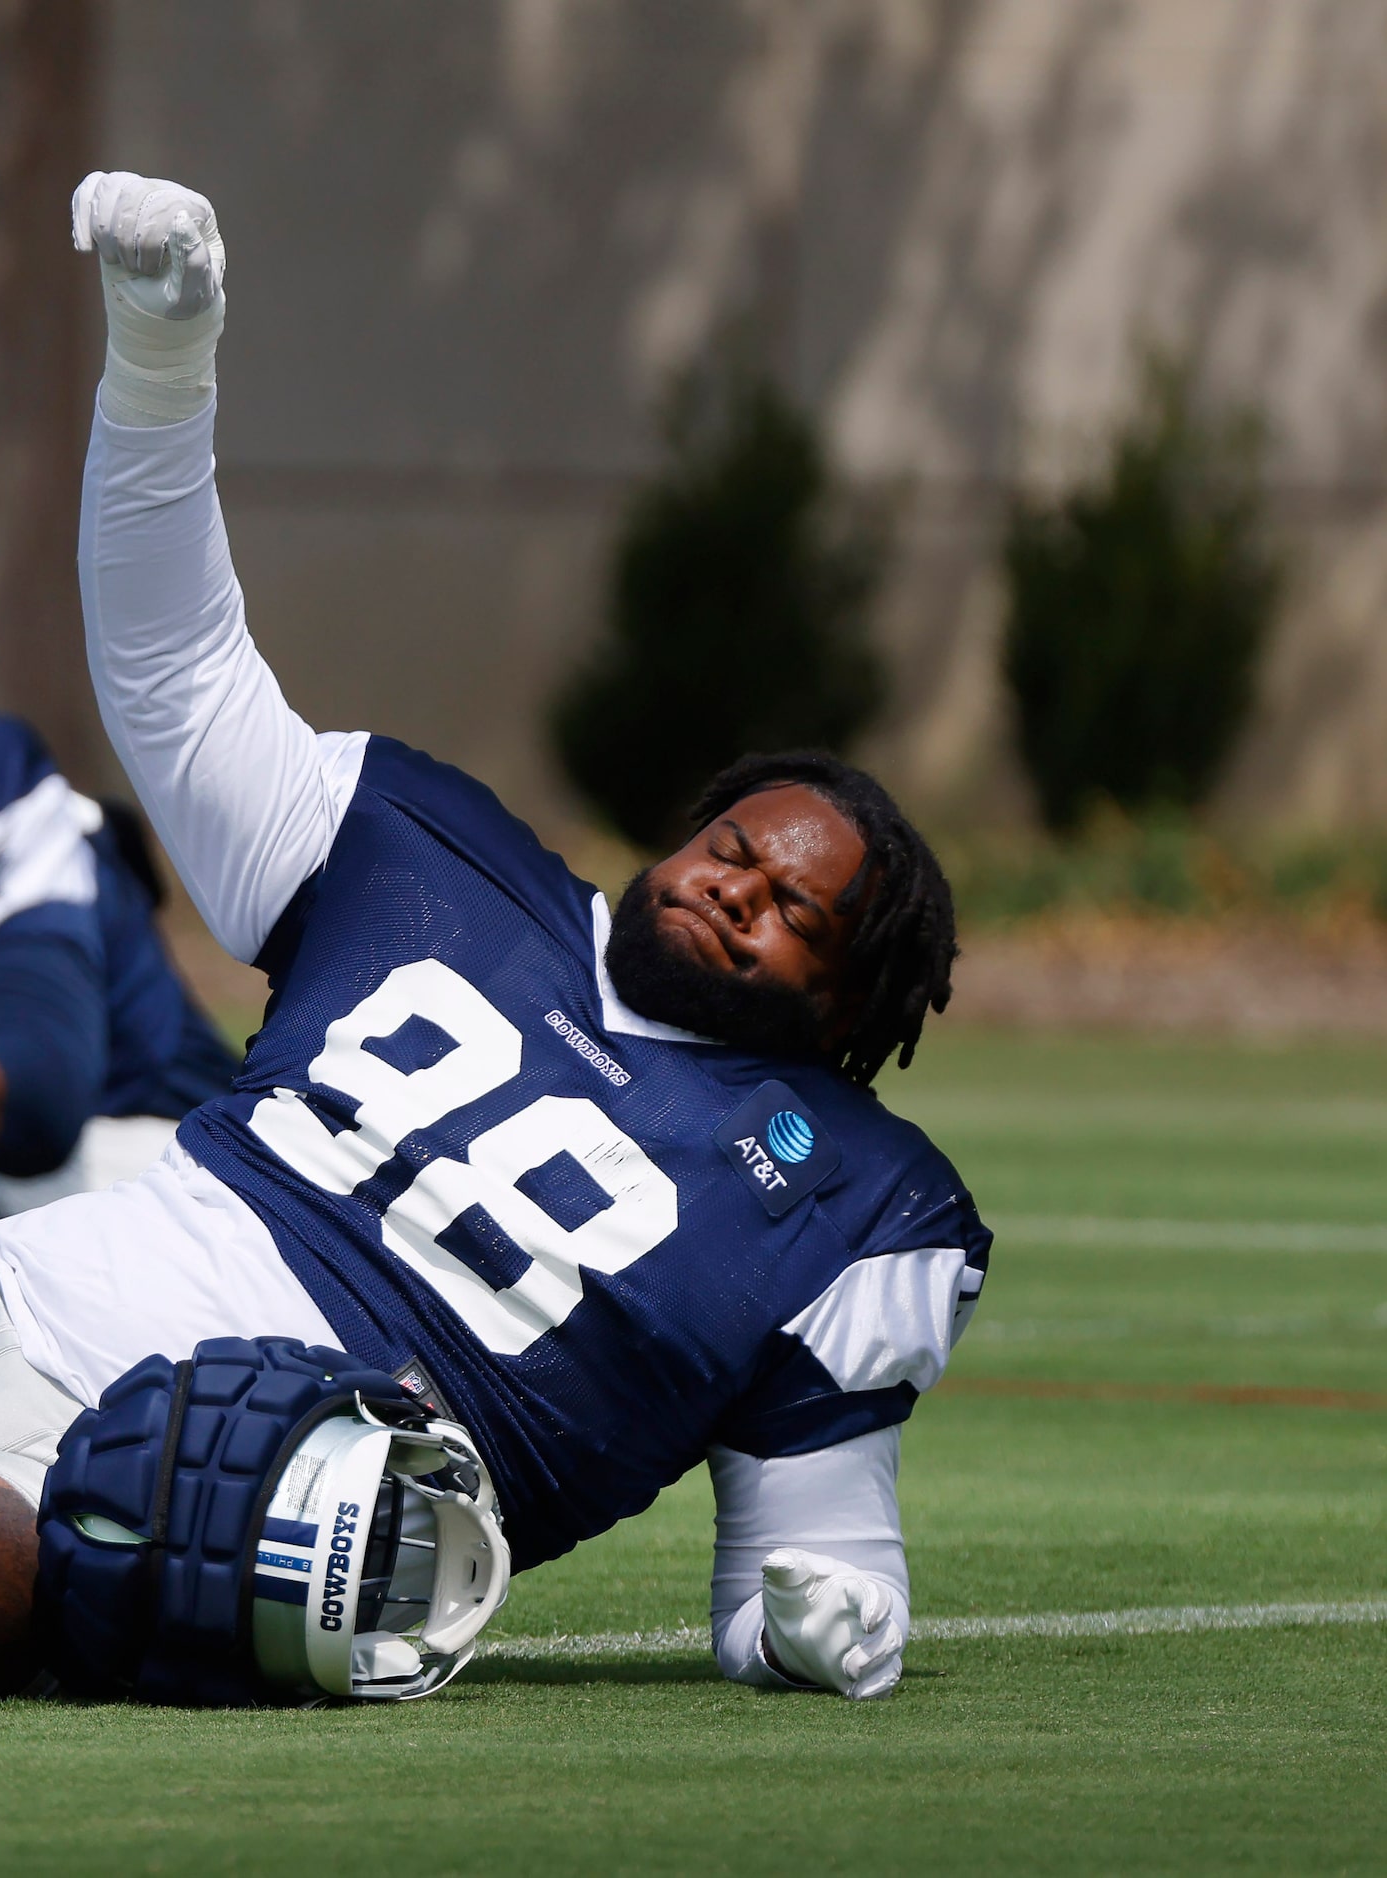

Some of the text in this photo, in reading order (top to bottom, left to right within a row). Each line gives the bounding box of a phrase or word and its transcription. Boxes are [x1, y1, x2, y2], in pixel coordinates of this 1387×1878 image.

[544, 1009, 632, 1087] COWBOYS
[247, 957, 680, 1356] 98
[734, 1136, 788, 1190] AT&T
[320, 1501, 361, 1632] COWBOYS
